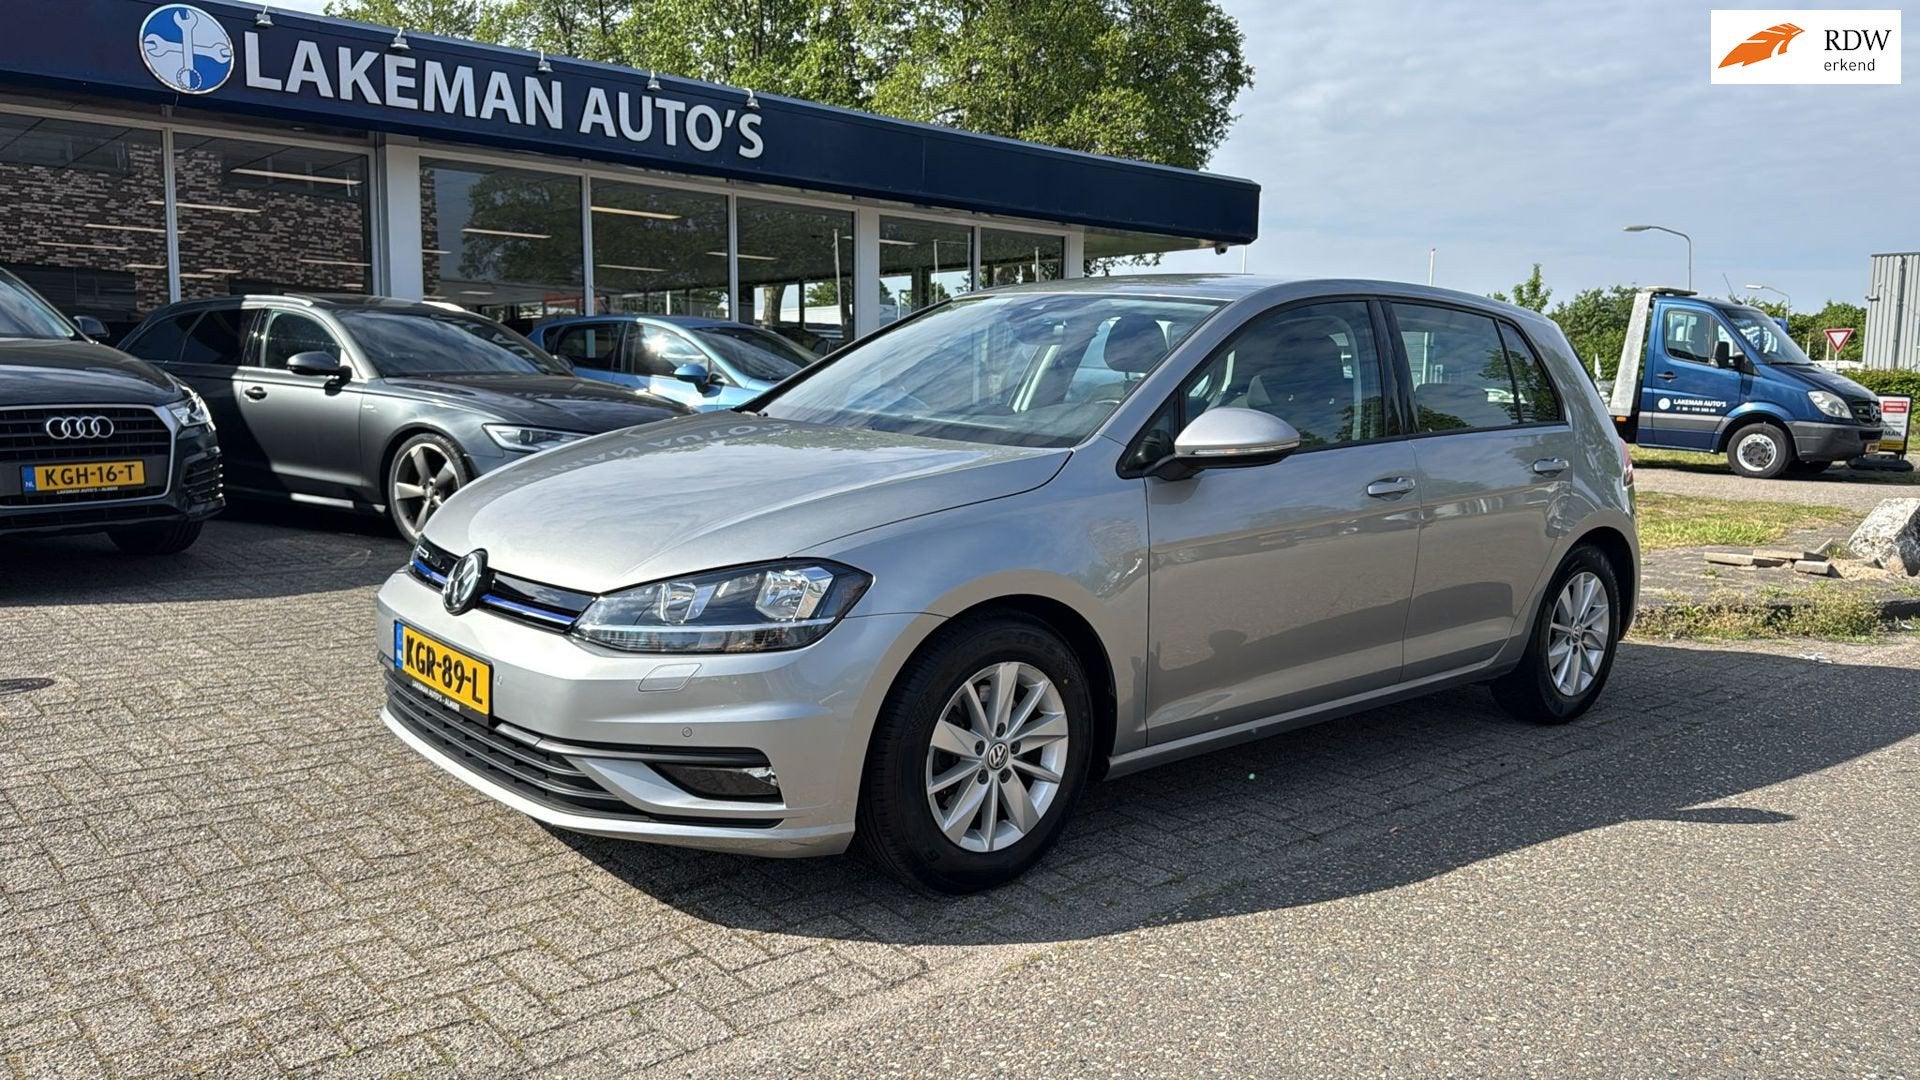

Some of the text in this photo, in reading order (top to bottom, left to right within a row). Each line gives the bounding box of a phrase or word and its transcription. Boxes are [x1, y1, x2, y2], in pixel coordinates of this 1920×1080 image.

[244, 31, 764, 159] LAKEMAN AUTO'S
[1673, 398, 1703, 407] LAKEMAN
[45, 464, 135, 486] KGH-16-T
[406, 635, 484, 705] KGR-89-L
